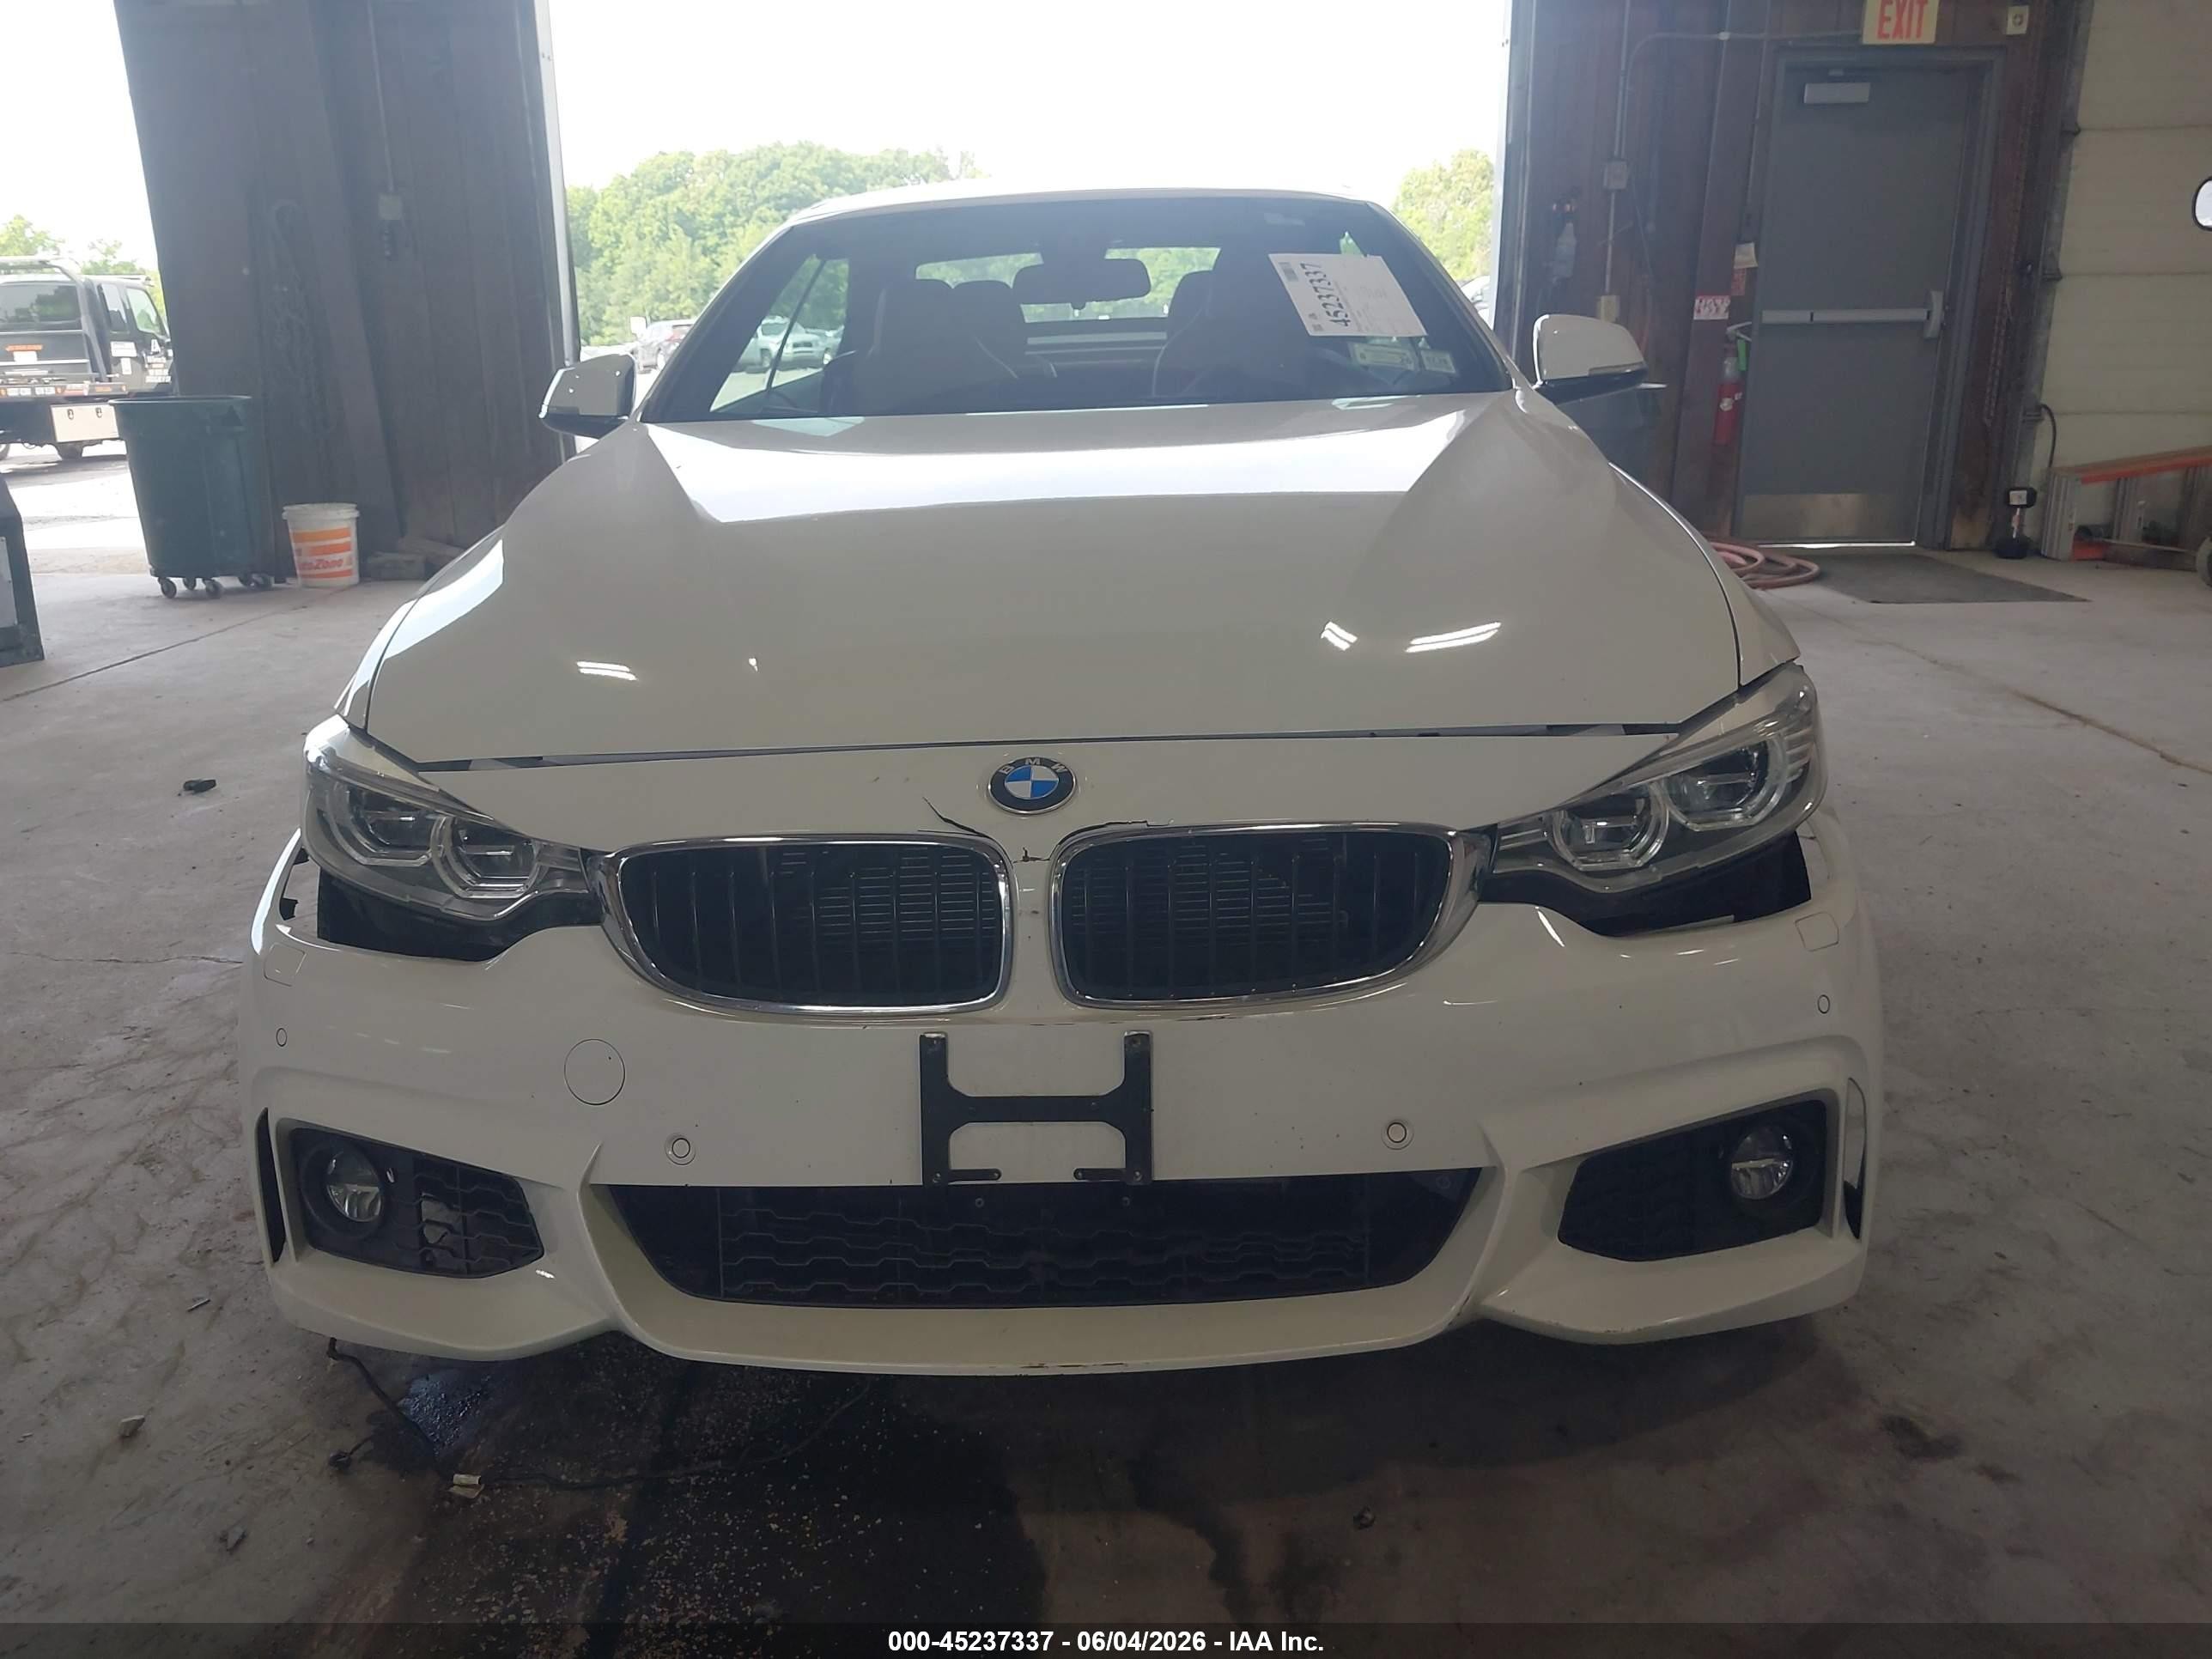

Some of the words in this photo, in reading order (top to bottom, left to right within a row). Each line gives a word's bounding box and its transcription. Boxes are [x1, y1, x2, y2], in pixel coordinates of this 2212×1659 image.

[1876, 0, 1929, 40] EXIT
[1299, 262, 1351, 327] 45237337
[999, 757, 1068, 775] BMW
